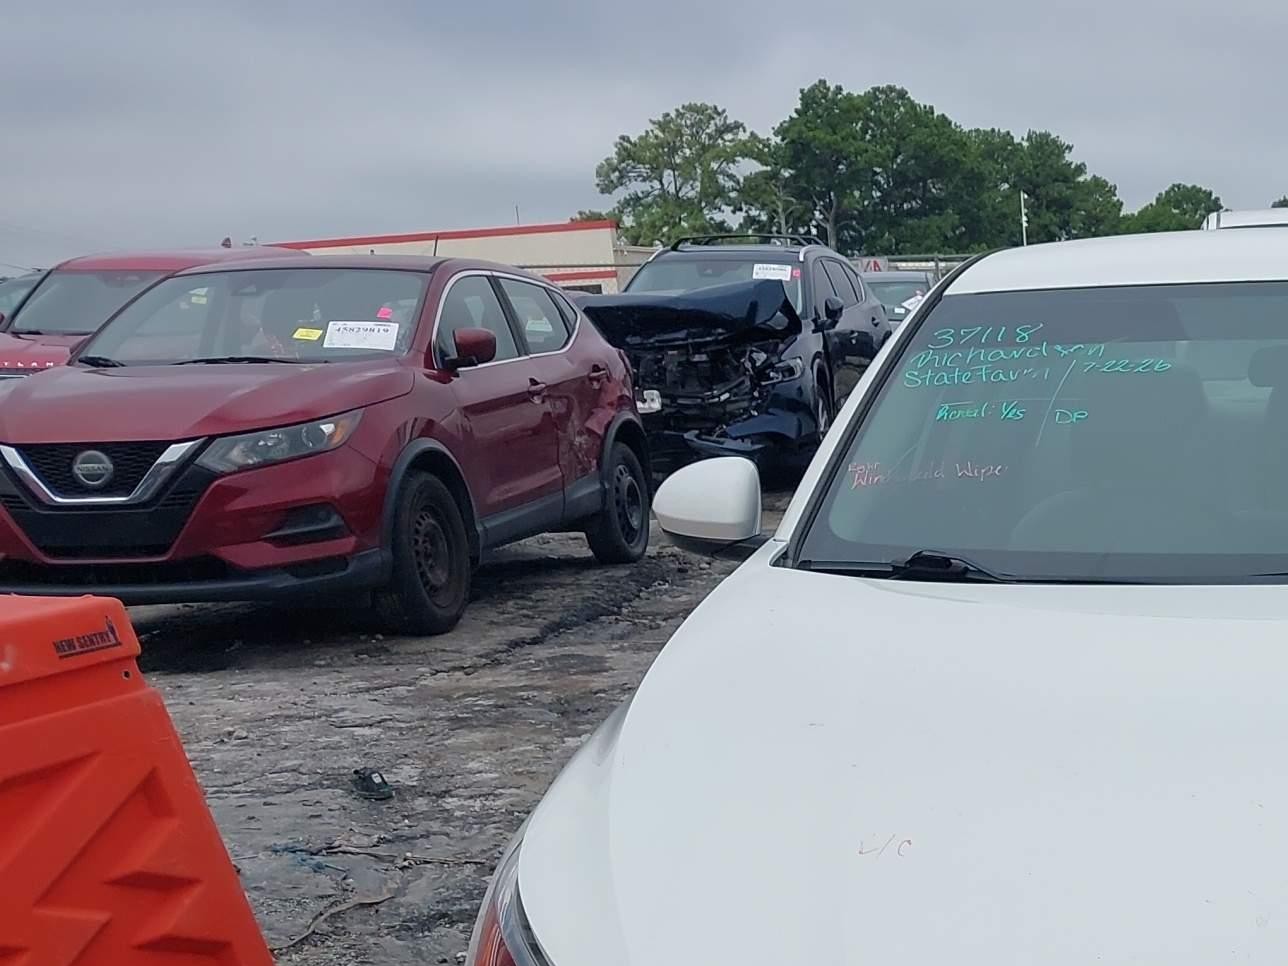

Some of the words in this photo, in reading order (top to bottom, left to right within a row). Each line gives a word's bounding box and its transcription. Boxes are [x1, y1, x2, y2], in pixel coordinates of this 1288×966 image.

[927, 323, 1044, 349] 37118
[52, 637, 77, 654] NEW
[76, 630, 113, 649] SENTRY
